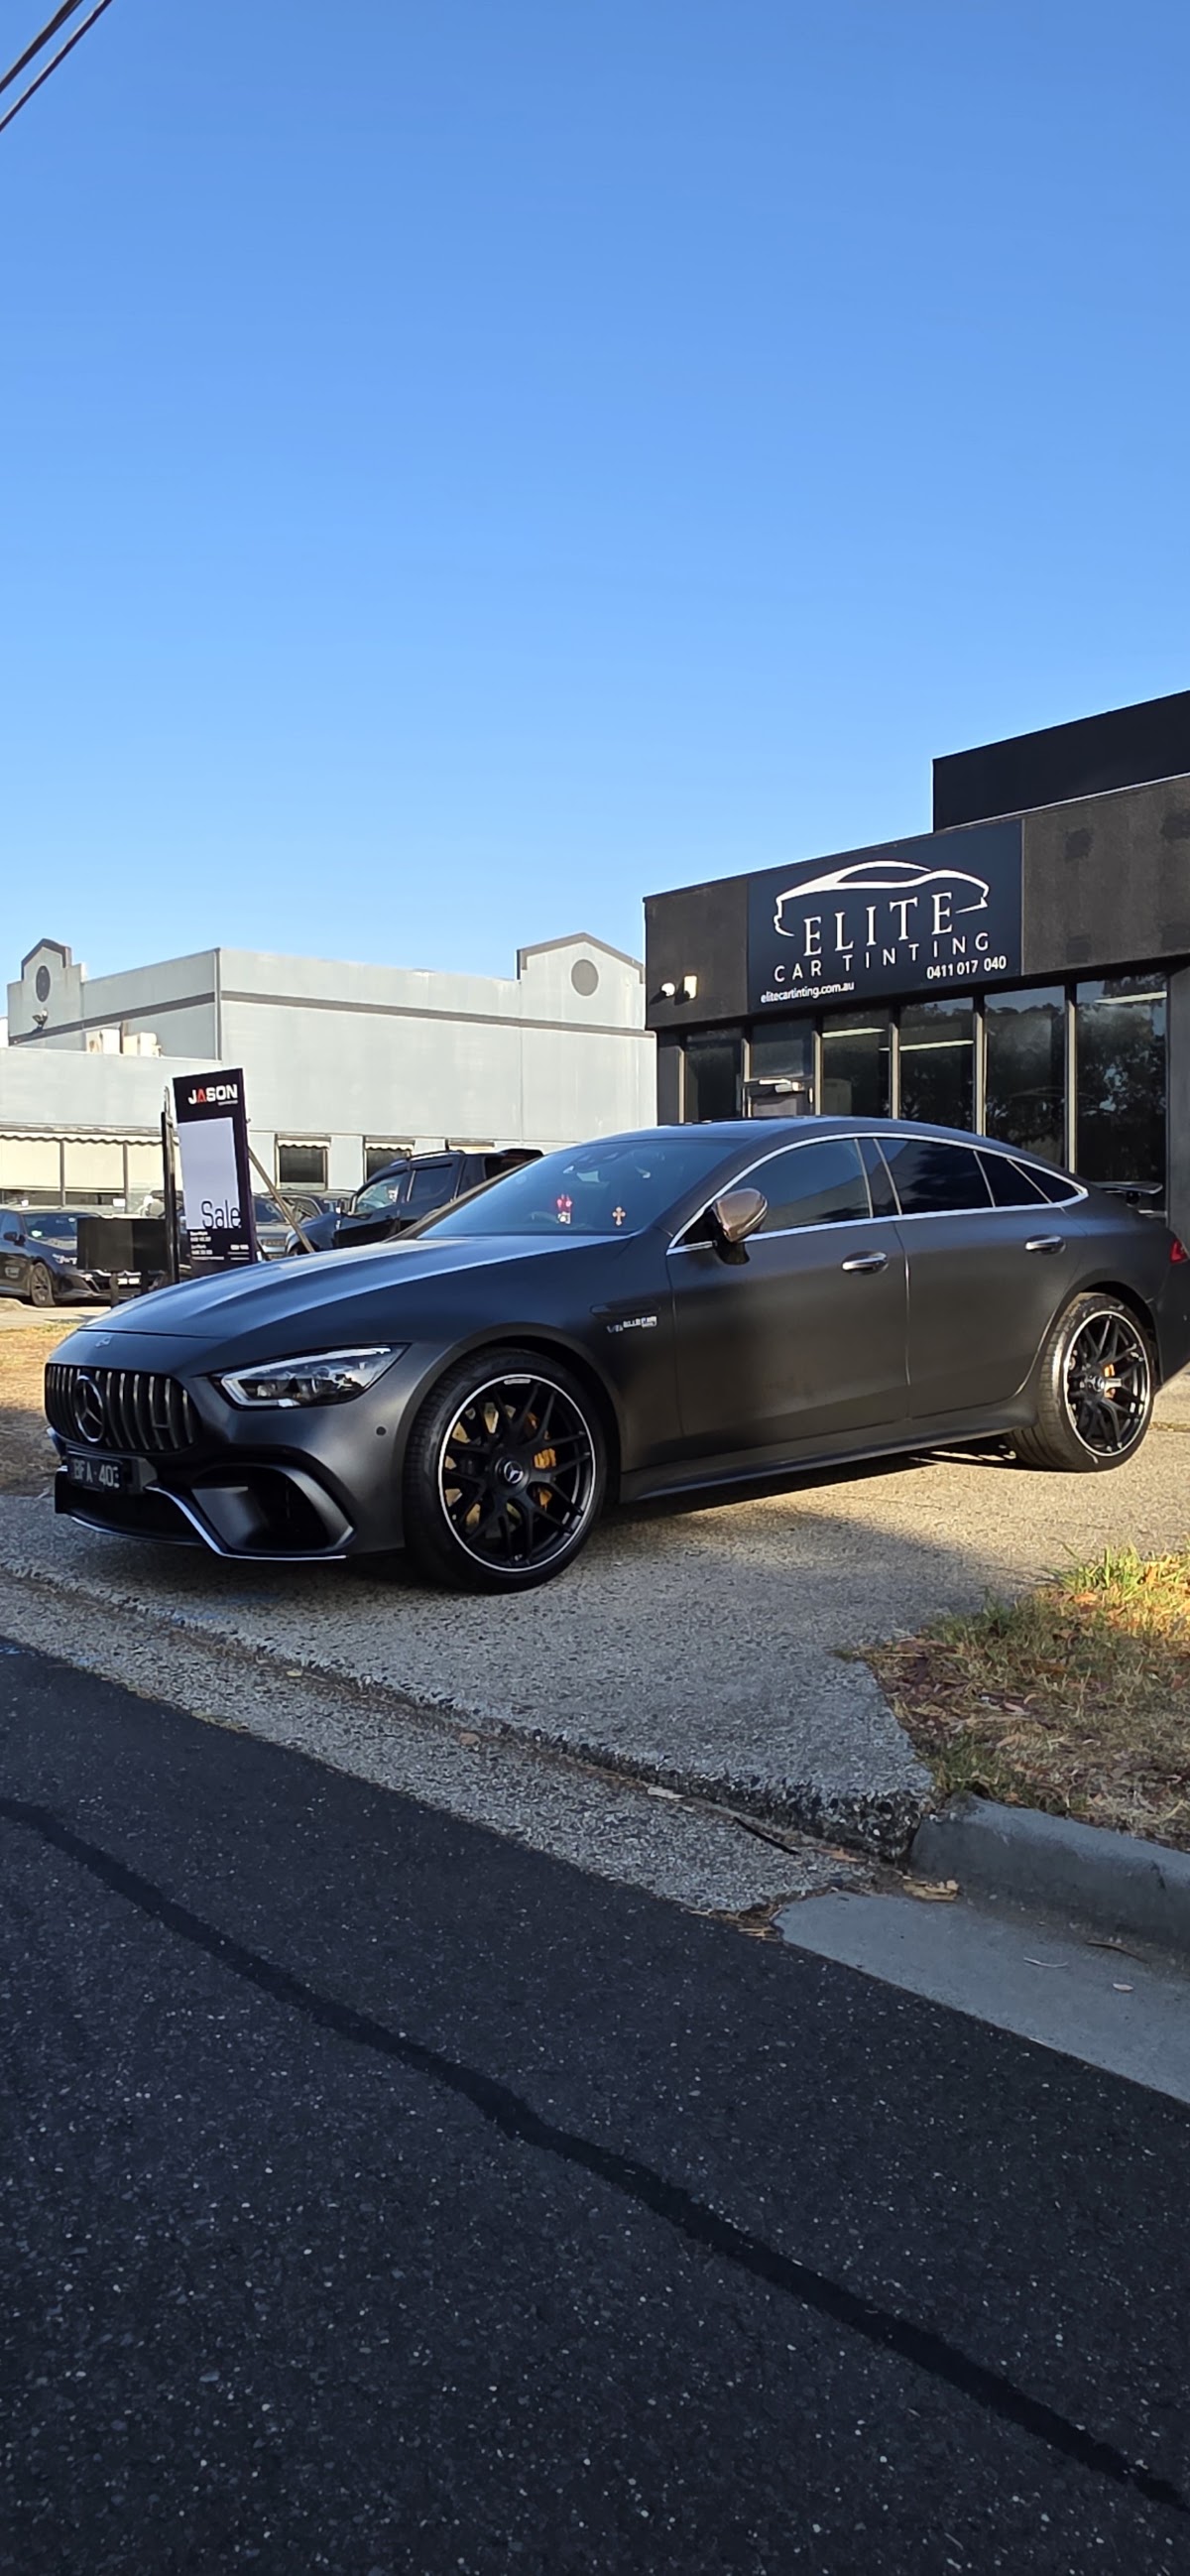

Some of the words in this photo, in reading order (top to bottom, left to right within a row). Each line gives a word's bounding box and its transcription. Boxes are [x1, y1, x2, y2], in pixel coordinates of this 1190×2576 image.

[803, 892, 952, 957] ELITE
[774, 959, 822, 983] CAR
[843, 932, 989, 972] TINTING
[926, 963, 953, 979] 0411
[956, 959, 979, 975] 017
[984, 955, 1007, 971] 040
[761, 982, 855, 1003] elitecartinting.com.au
[187, 1084, 238, 1104] JASON
[201, 1199, 241, 1229] Sale
